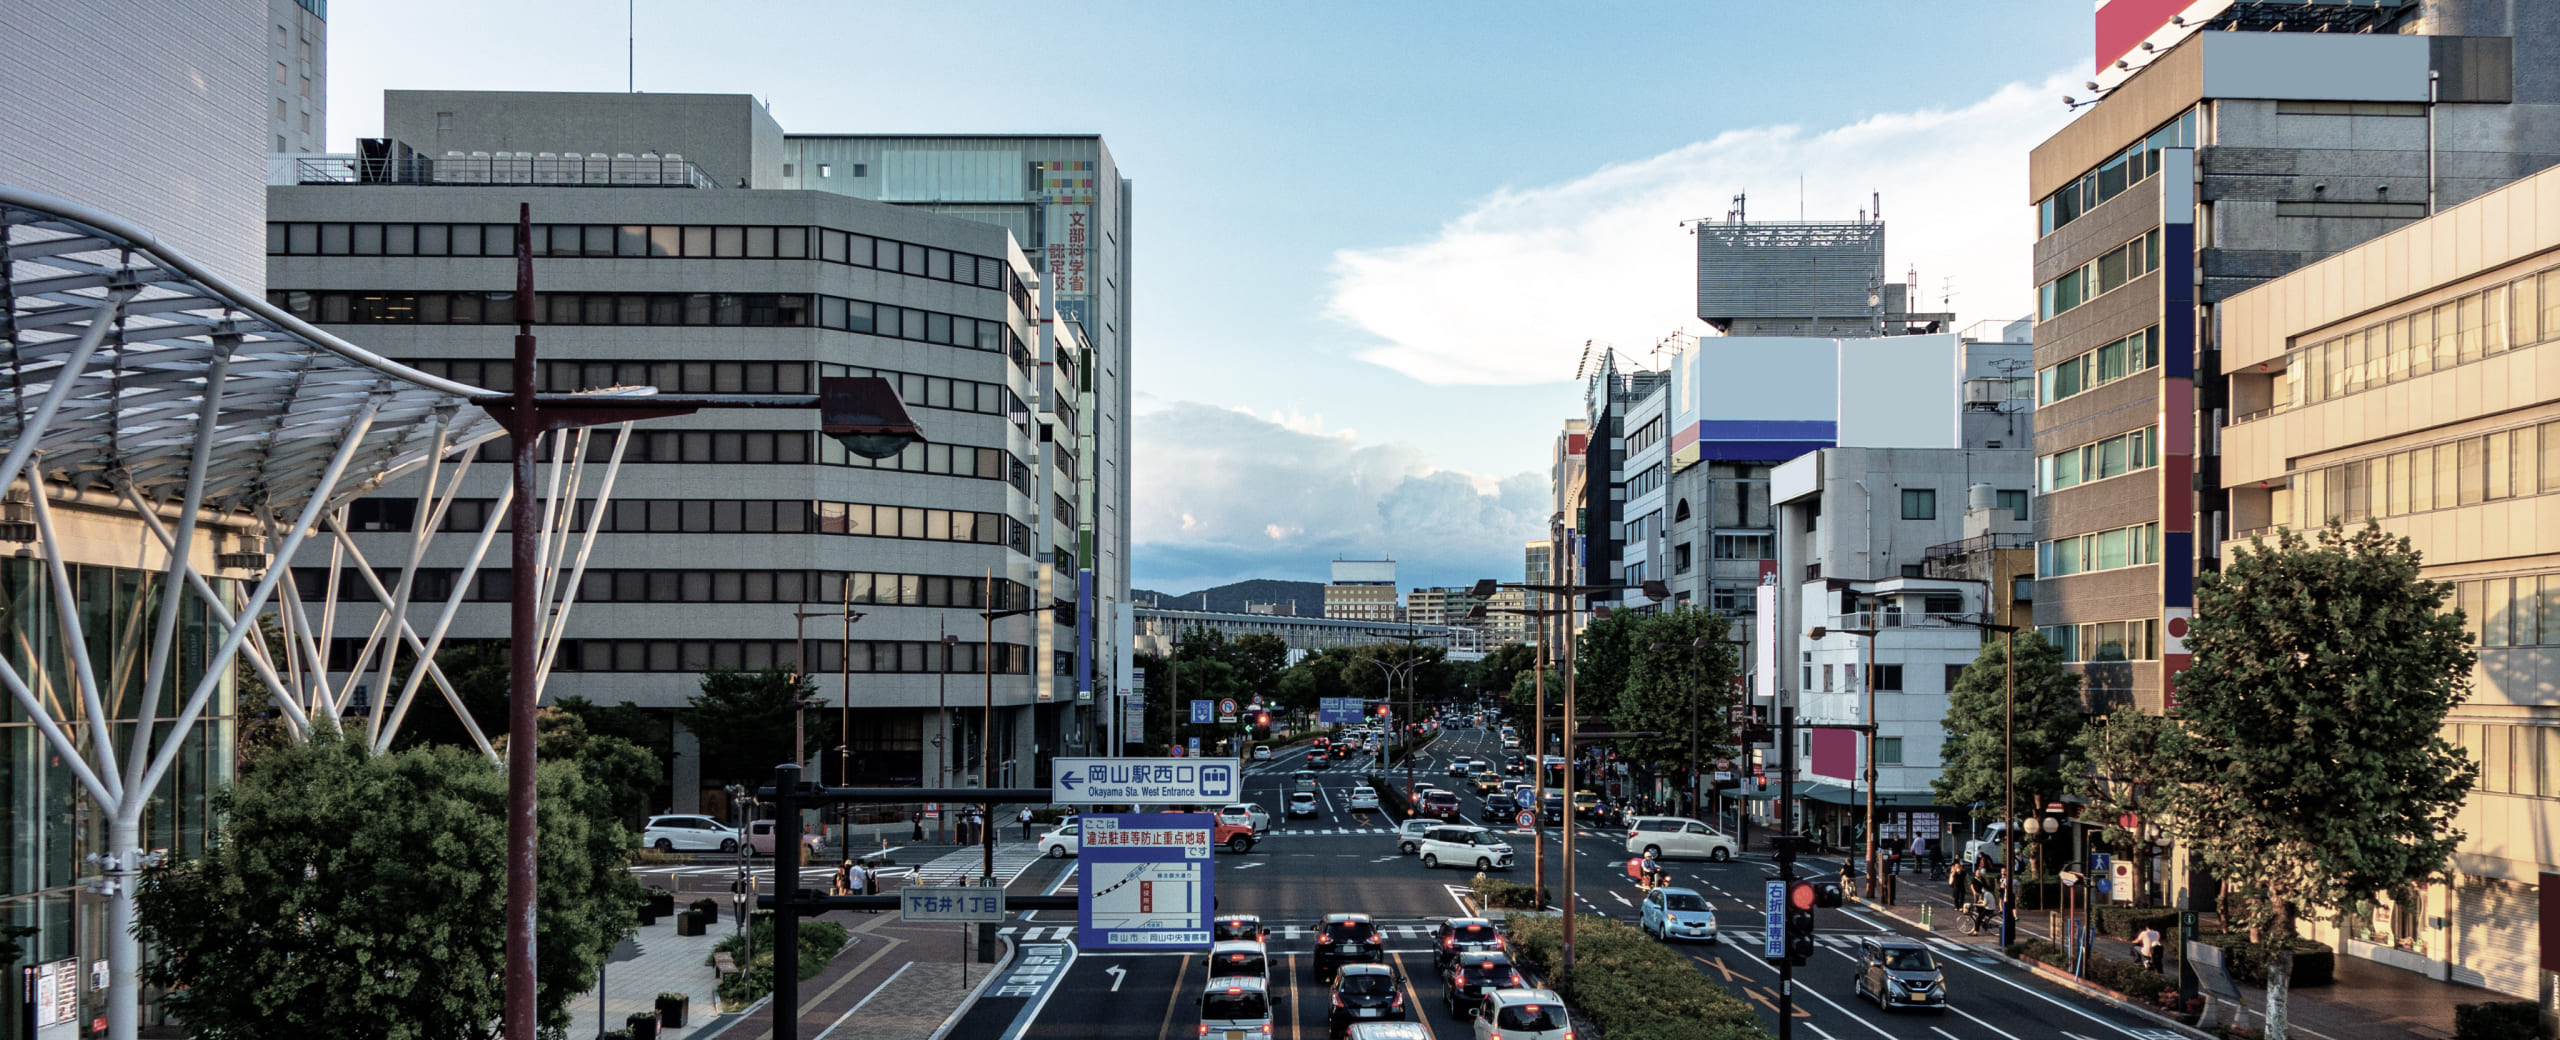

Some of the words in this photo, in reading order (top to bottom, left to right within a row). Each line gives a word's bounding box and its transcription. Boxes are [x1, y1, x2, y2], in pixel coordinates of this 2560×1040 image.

[1069, 211, 1085, 292] 文部科学省
[1192, 739, 1199, 748] P
[1089, 765, 1194, 784] 岡山駅西口
[1088, 786, 1123, 798] Okayama
[1125, 786, 1139, 797] Sta.
[1141, 786, 1160, 797] West
[1162, 786, 1195, 797] Entrance
[1085, 819, 1116, 830] ここは
[1086, 831, 1206, 846] 違法駐車等防止重点地域
[1188, 846, 1207, 857] です
[909, 896, 997, 913] 下石井1丁目
[1769, 885, 1783, 953] 右折車専用
